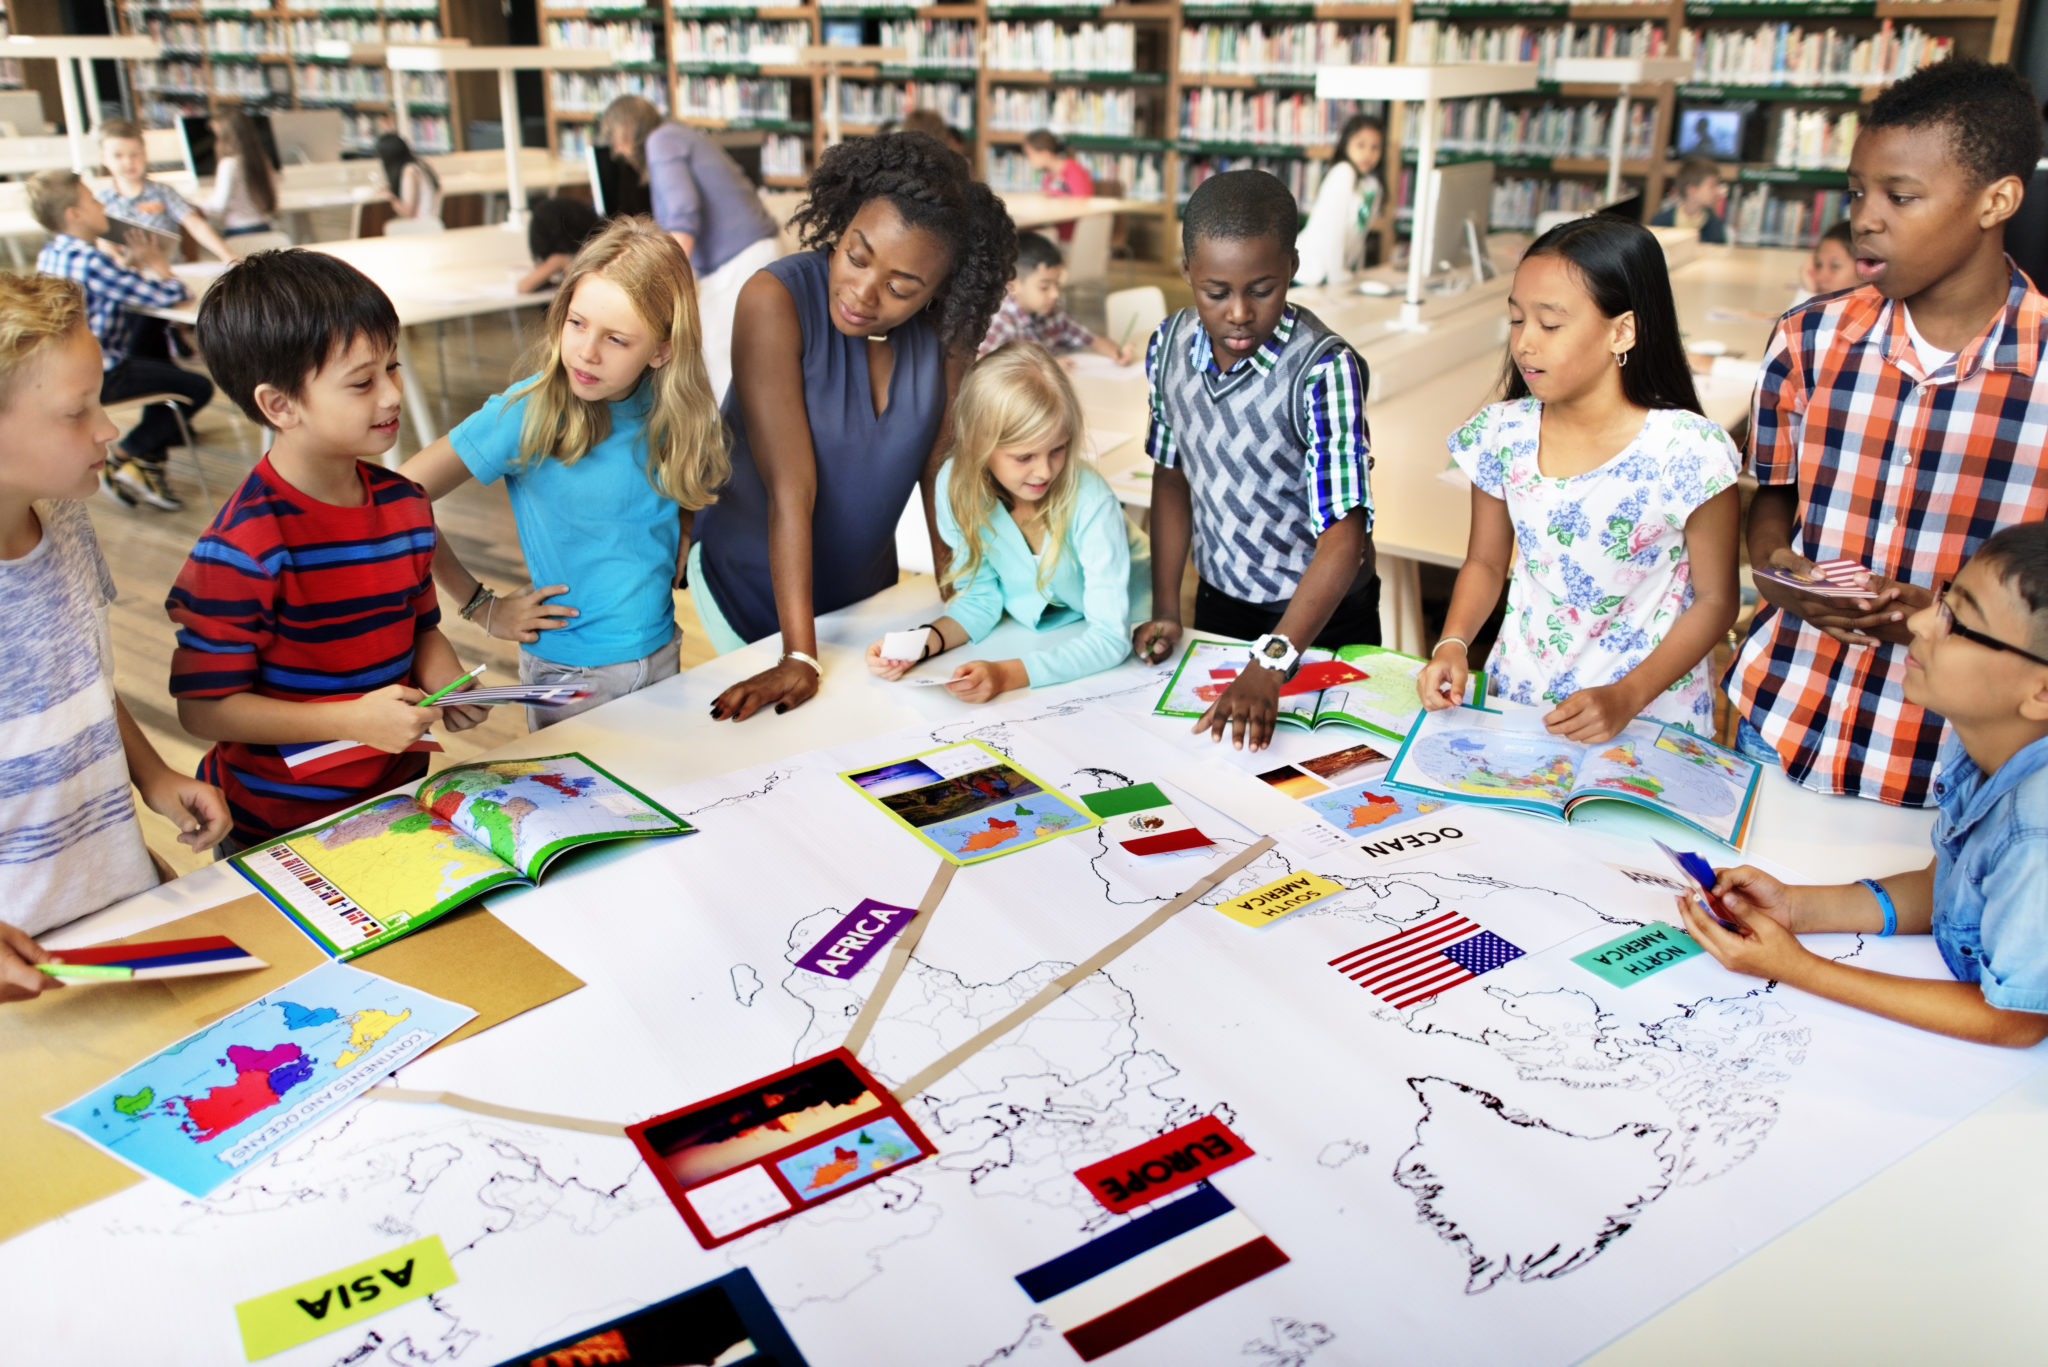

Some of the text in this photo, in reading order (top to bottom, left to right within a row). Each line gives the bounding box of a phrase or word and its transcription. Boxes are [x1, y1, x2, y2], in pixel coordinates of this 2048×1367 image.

[1360, 827, 1463, 858] OCEAN
[1236, 877, 1311, 910] AMERICA
[1261, 890, 1321, 917] SOUTH
[815, 909, 901, 976] AFRICA
[1592, 929, 1669, 966] AMERICA
[1623, 945, 1688, 976] NORTH
[231, 1033, 423, 1161] CONTINENTS AND OCEANS
[1098, 1132, 1235, 1203] EUROPE
[296, 1257, 415, 1321] ASIA
